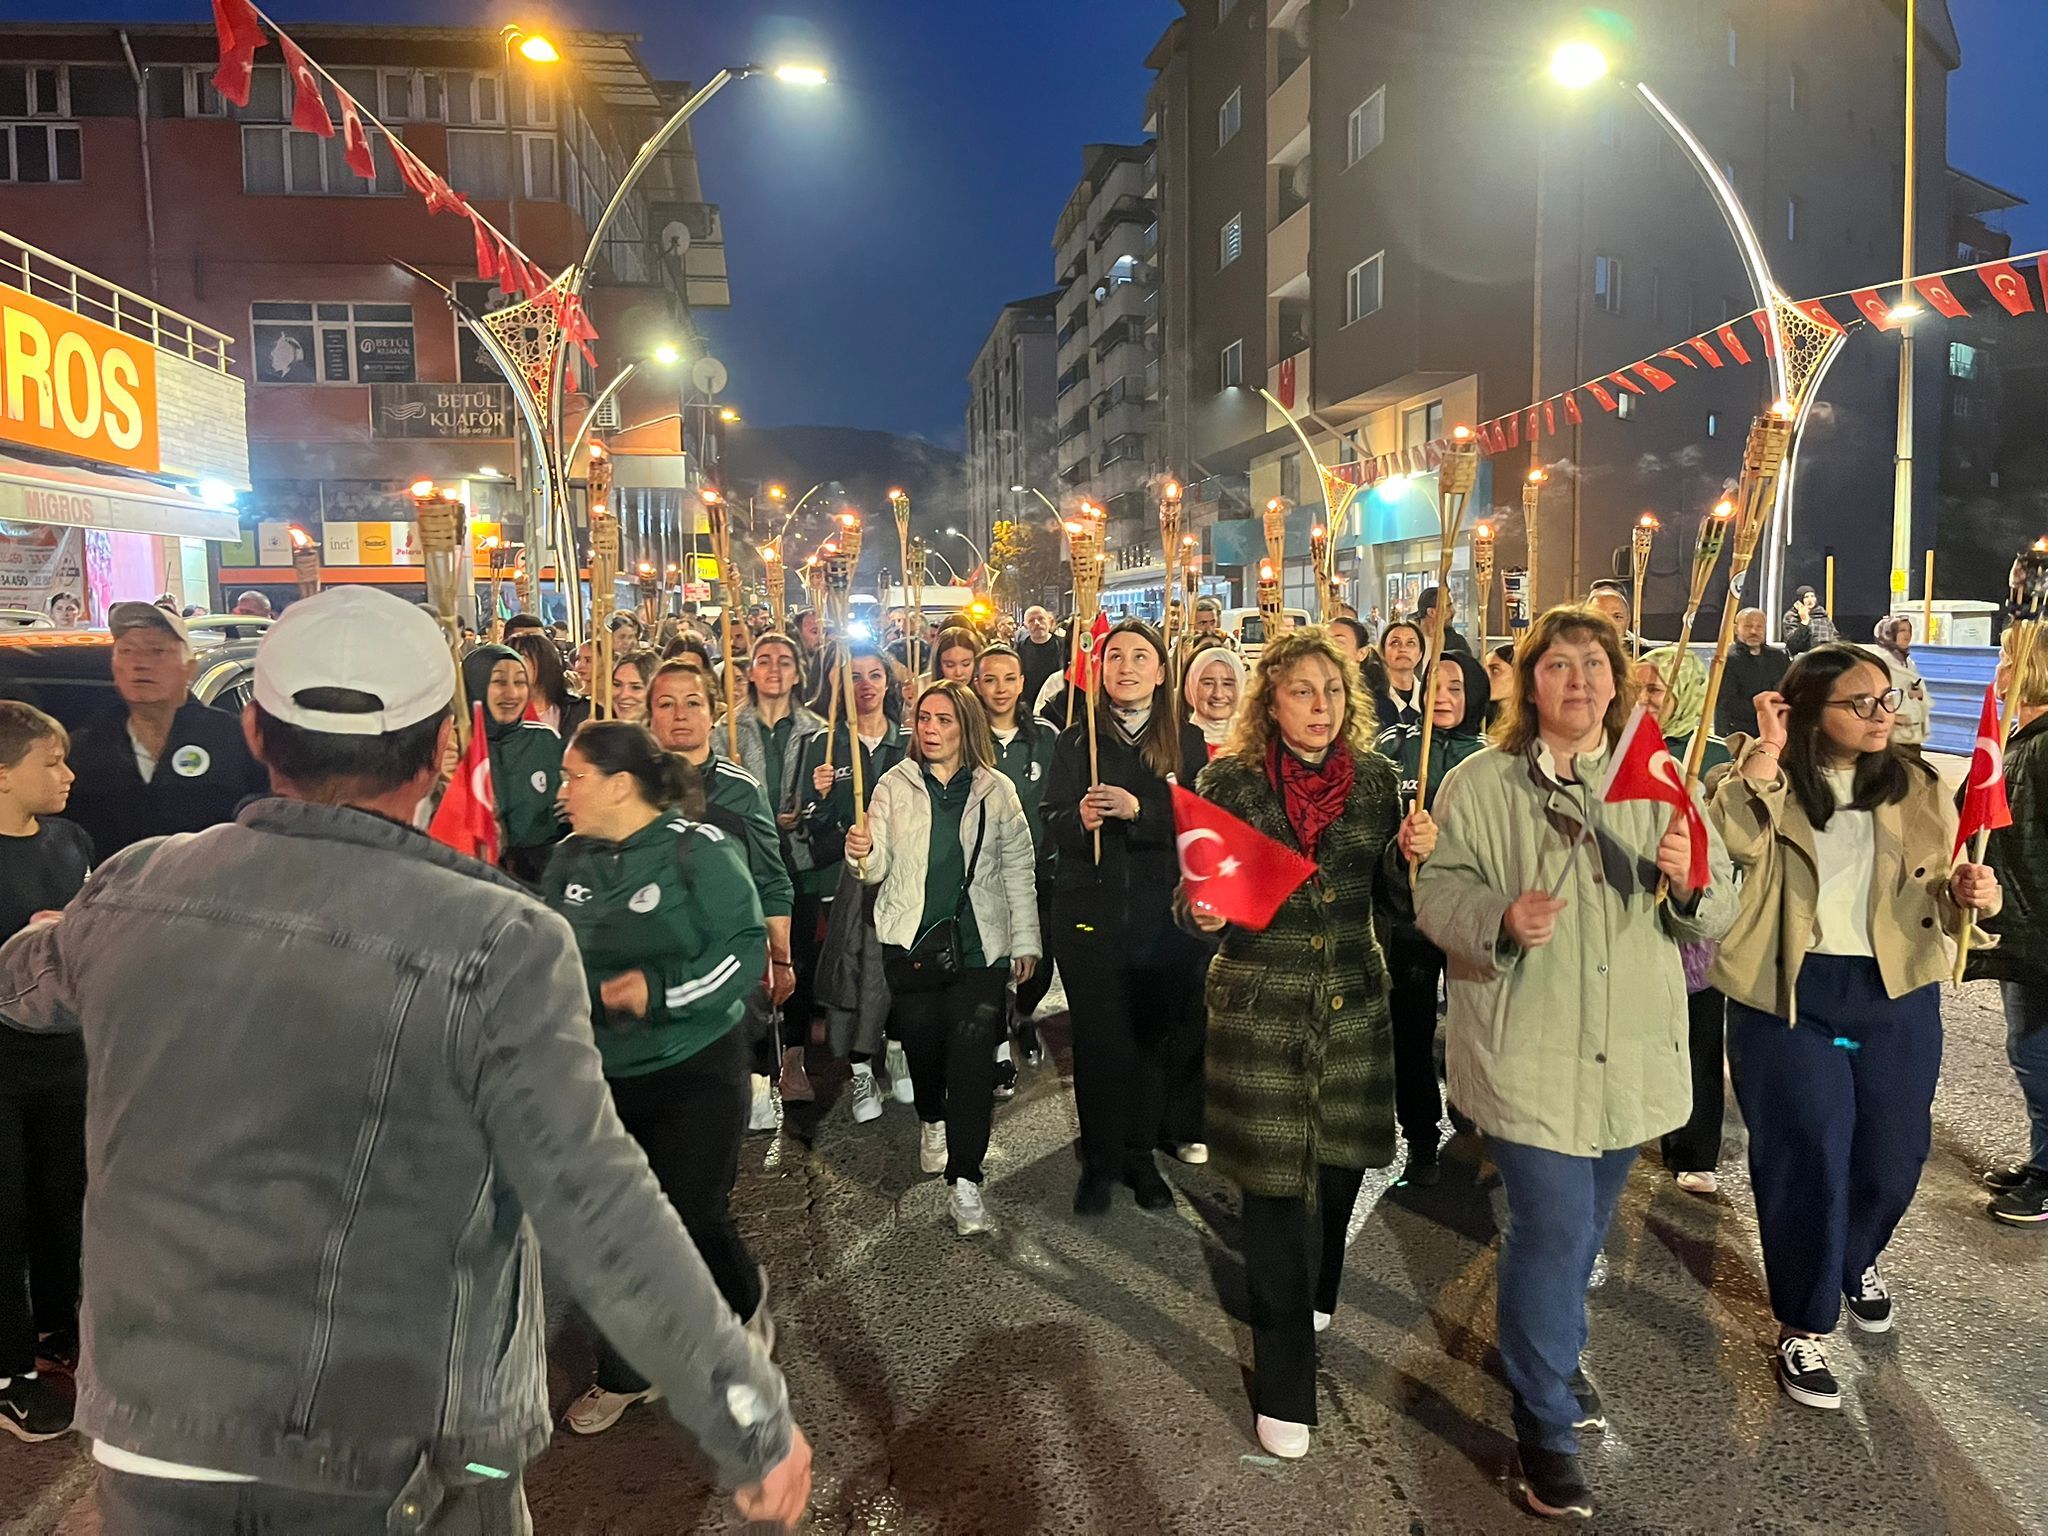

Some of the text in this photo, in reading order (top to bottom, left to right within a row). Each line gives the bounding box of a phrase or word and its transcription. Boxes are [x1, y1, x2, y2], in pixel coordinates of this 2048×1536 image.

[0, 305, 143, 451] ROS
[437, 391, 497, 408] BETÜL
[430, 409, 505, 427] KUAFÖR
